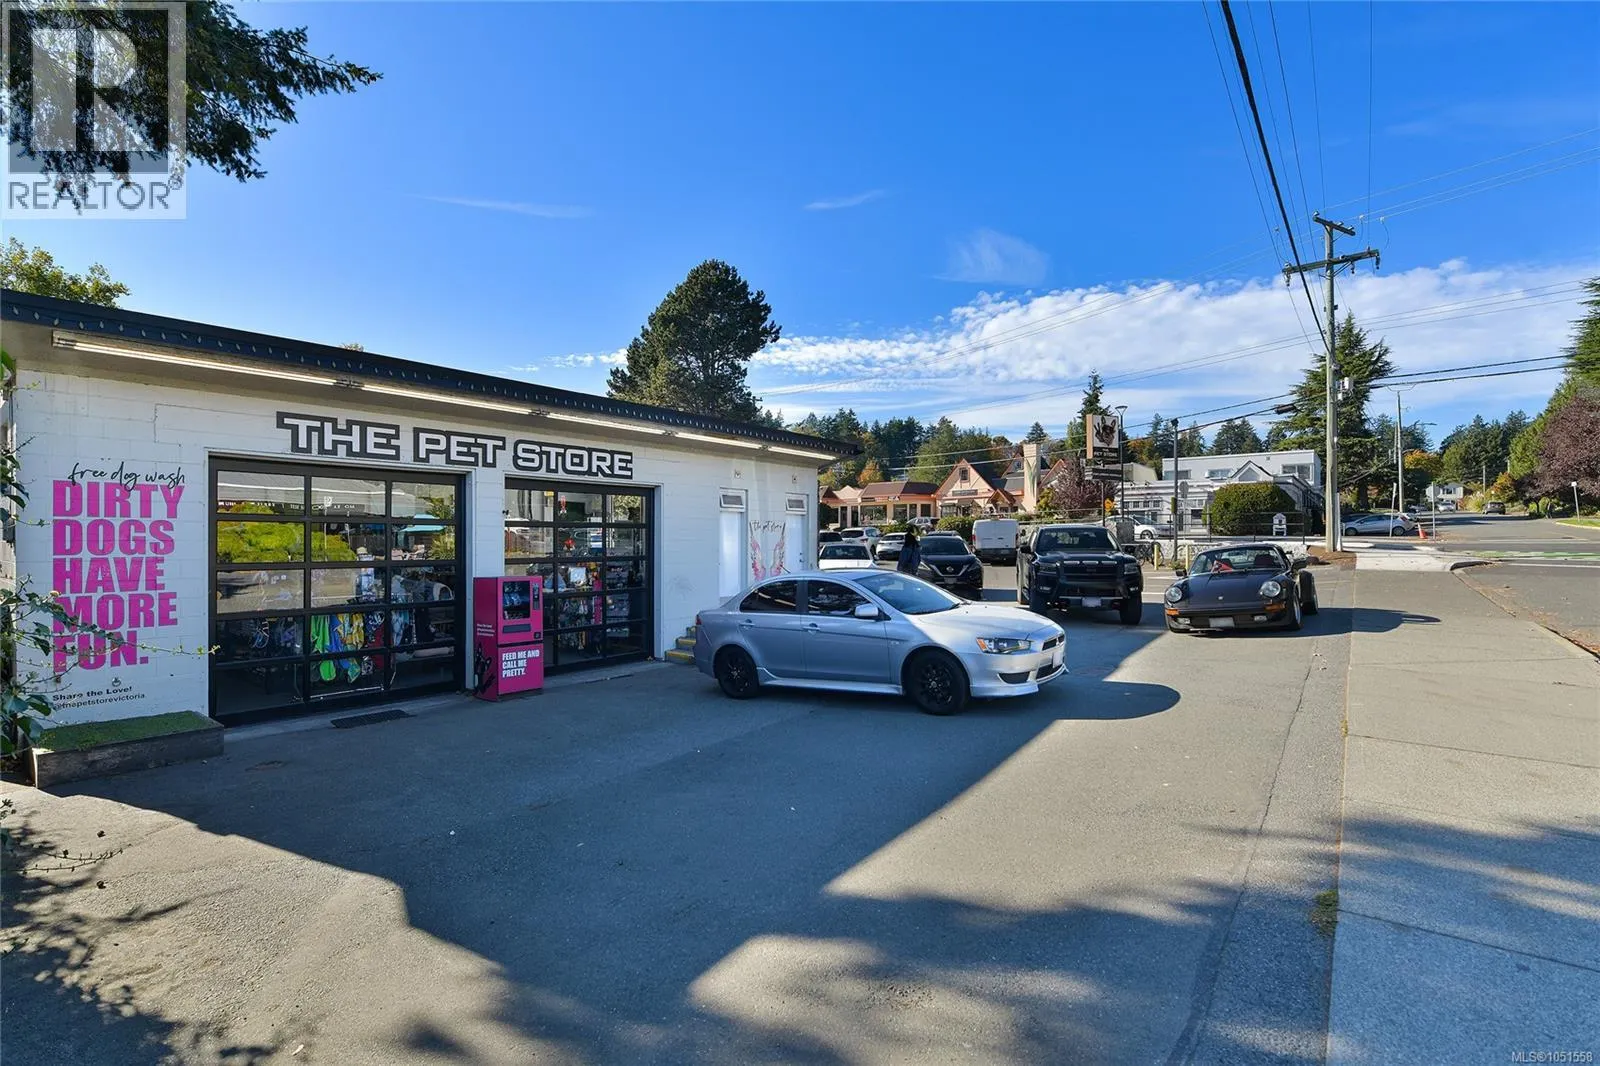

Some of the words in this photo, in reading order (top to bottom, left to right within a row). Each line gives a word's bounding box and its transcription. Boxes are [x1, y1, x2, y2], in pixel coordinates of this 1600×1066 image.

[277, 411, 400, 461] THE
[413, 427, 506, 467] PET
[513, 439, 633, 479] STORE
[68, 462, 107, 486] free
[111, 461, 140, 492] dog
[145, 467, 185, 489] wash
[53, 480, 185, 518] DIRTY
[53, 519, 175, 556] DOGS
[53, 556, 165, 594] HAVE
[53, 592, 178, 633] MORE
[53, 630, 148, 673] FUN.
[502, 652, 516, 661] FEED
[518, 651, 527, 659] ME
[527, 649, 540, 657] AND
[502, 660, 517, 669] CALL
[517, 659, 527, 668] ME
[52, 693, 83, 701] Share
[106, 686, 132, 695] Love!
